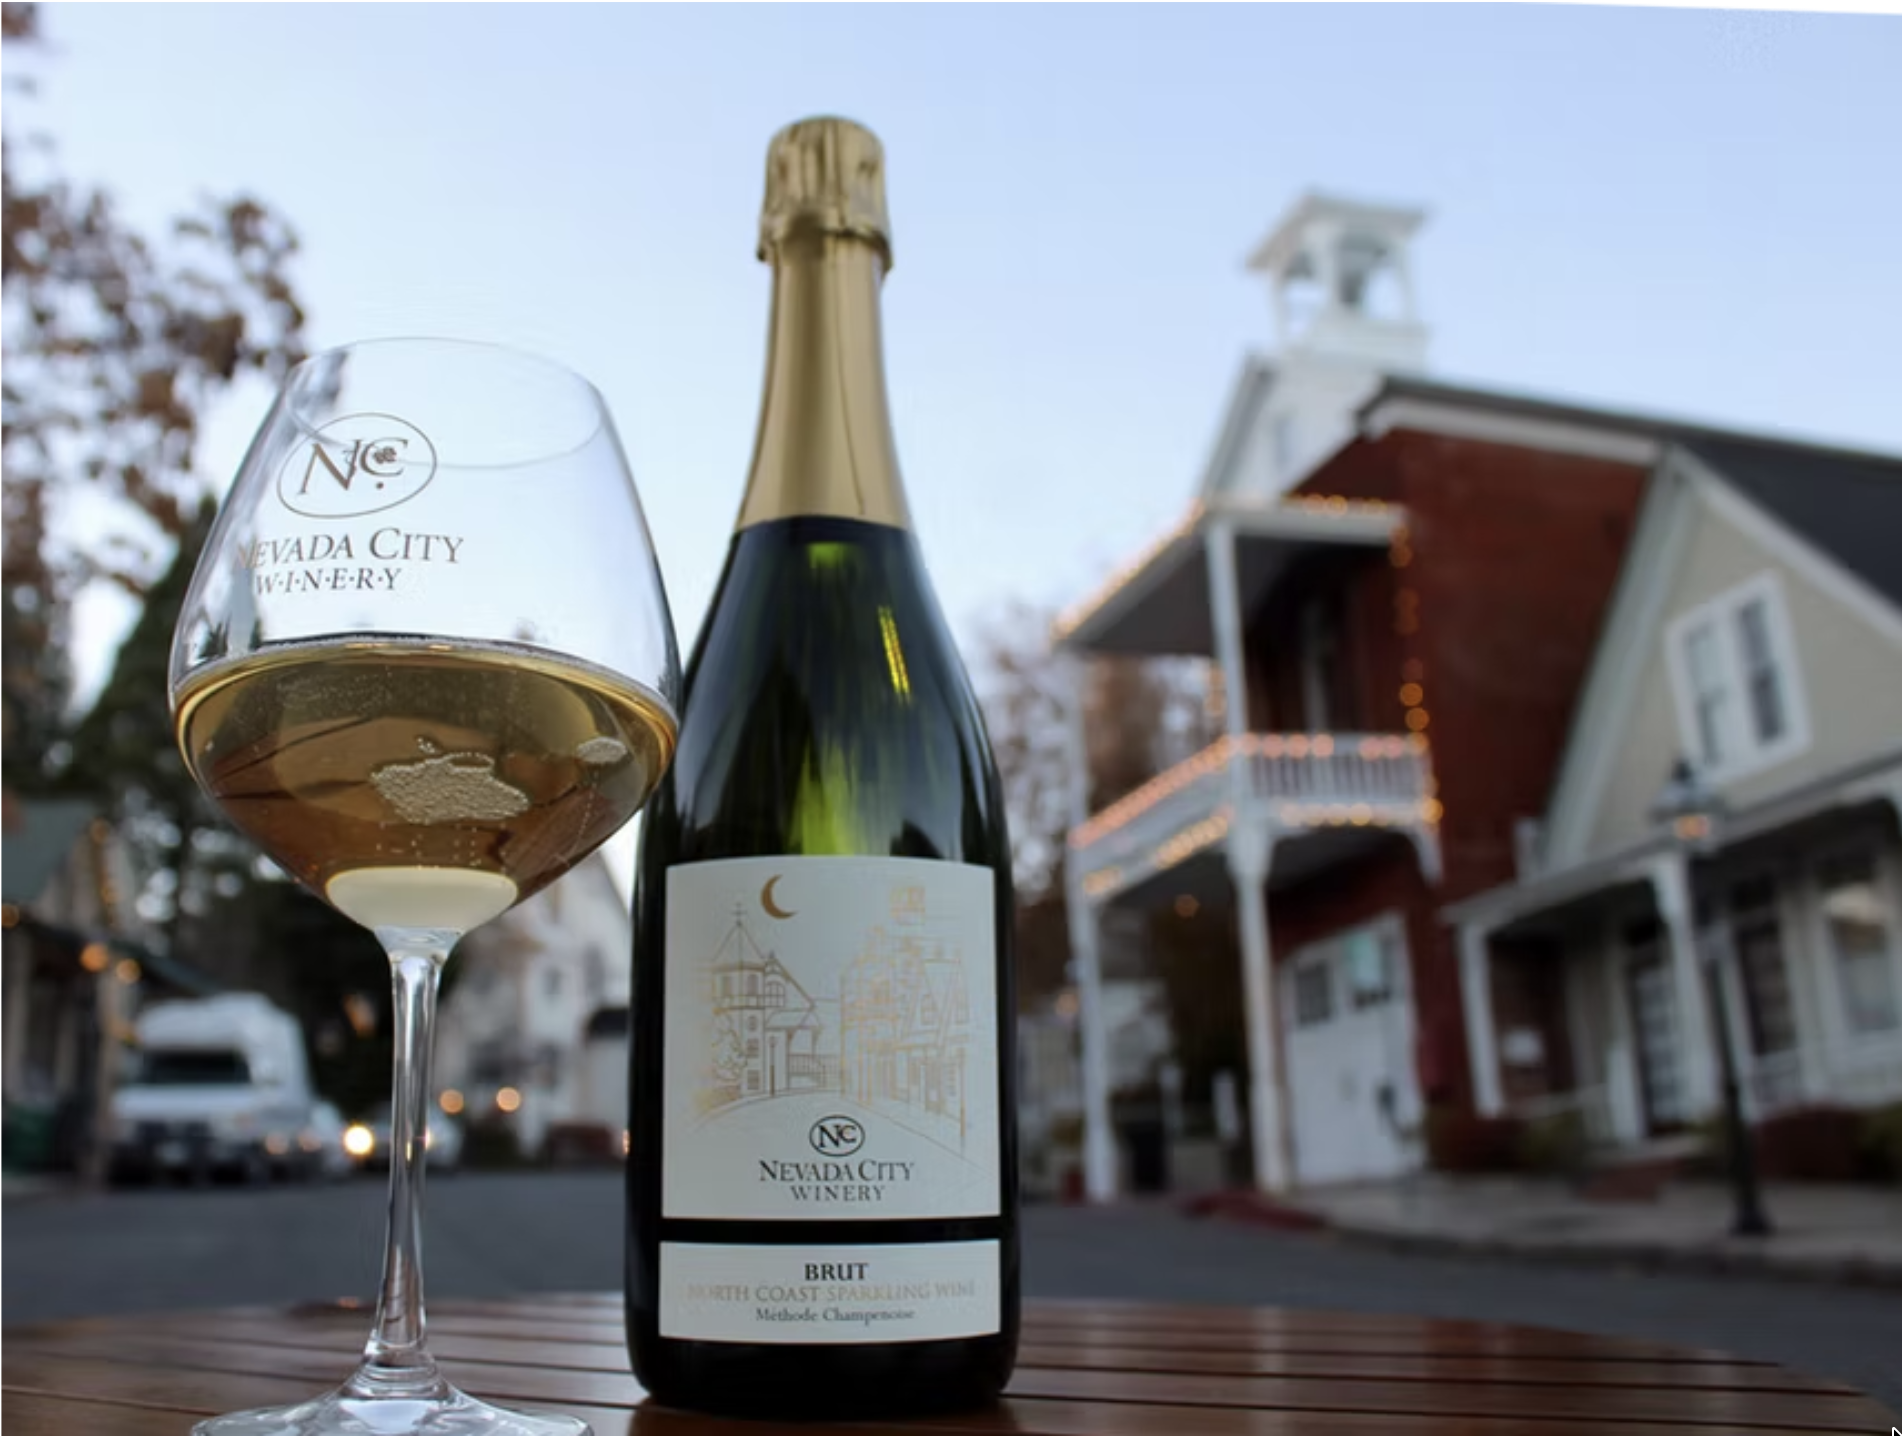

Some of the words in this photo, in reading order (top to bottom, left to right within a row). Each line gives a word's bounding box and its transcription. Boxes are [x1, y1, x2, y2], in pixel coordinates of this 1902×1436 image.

[369, 527, 464, 563] CITY
[818, 1124, 857, 1148] NC
[759, 1160, 854, 1181] NEVADA
[858, 1159, 914, 1181] CITY
[791, 1185, 885, 1201] WINERY
[804, 1263, 868, 1281] BRUT
[755, 1285, 820, 1302] COAST
[827, 1282, 930, 1302] SPARKLING
[822, 1306, 915, 1326] Champenoise
